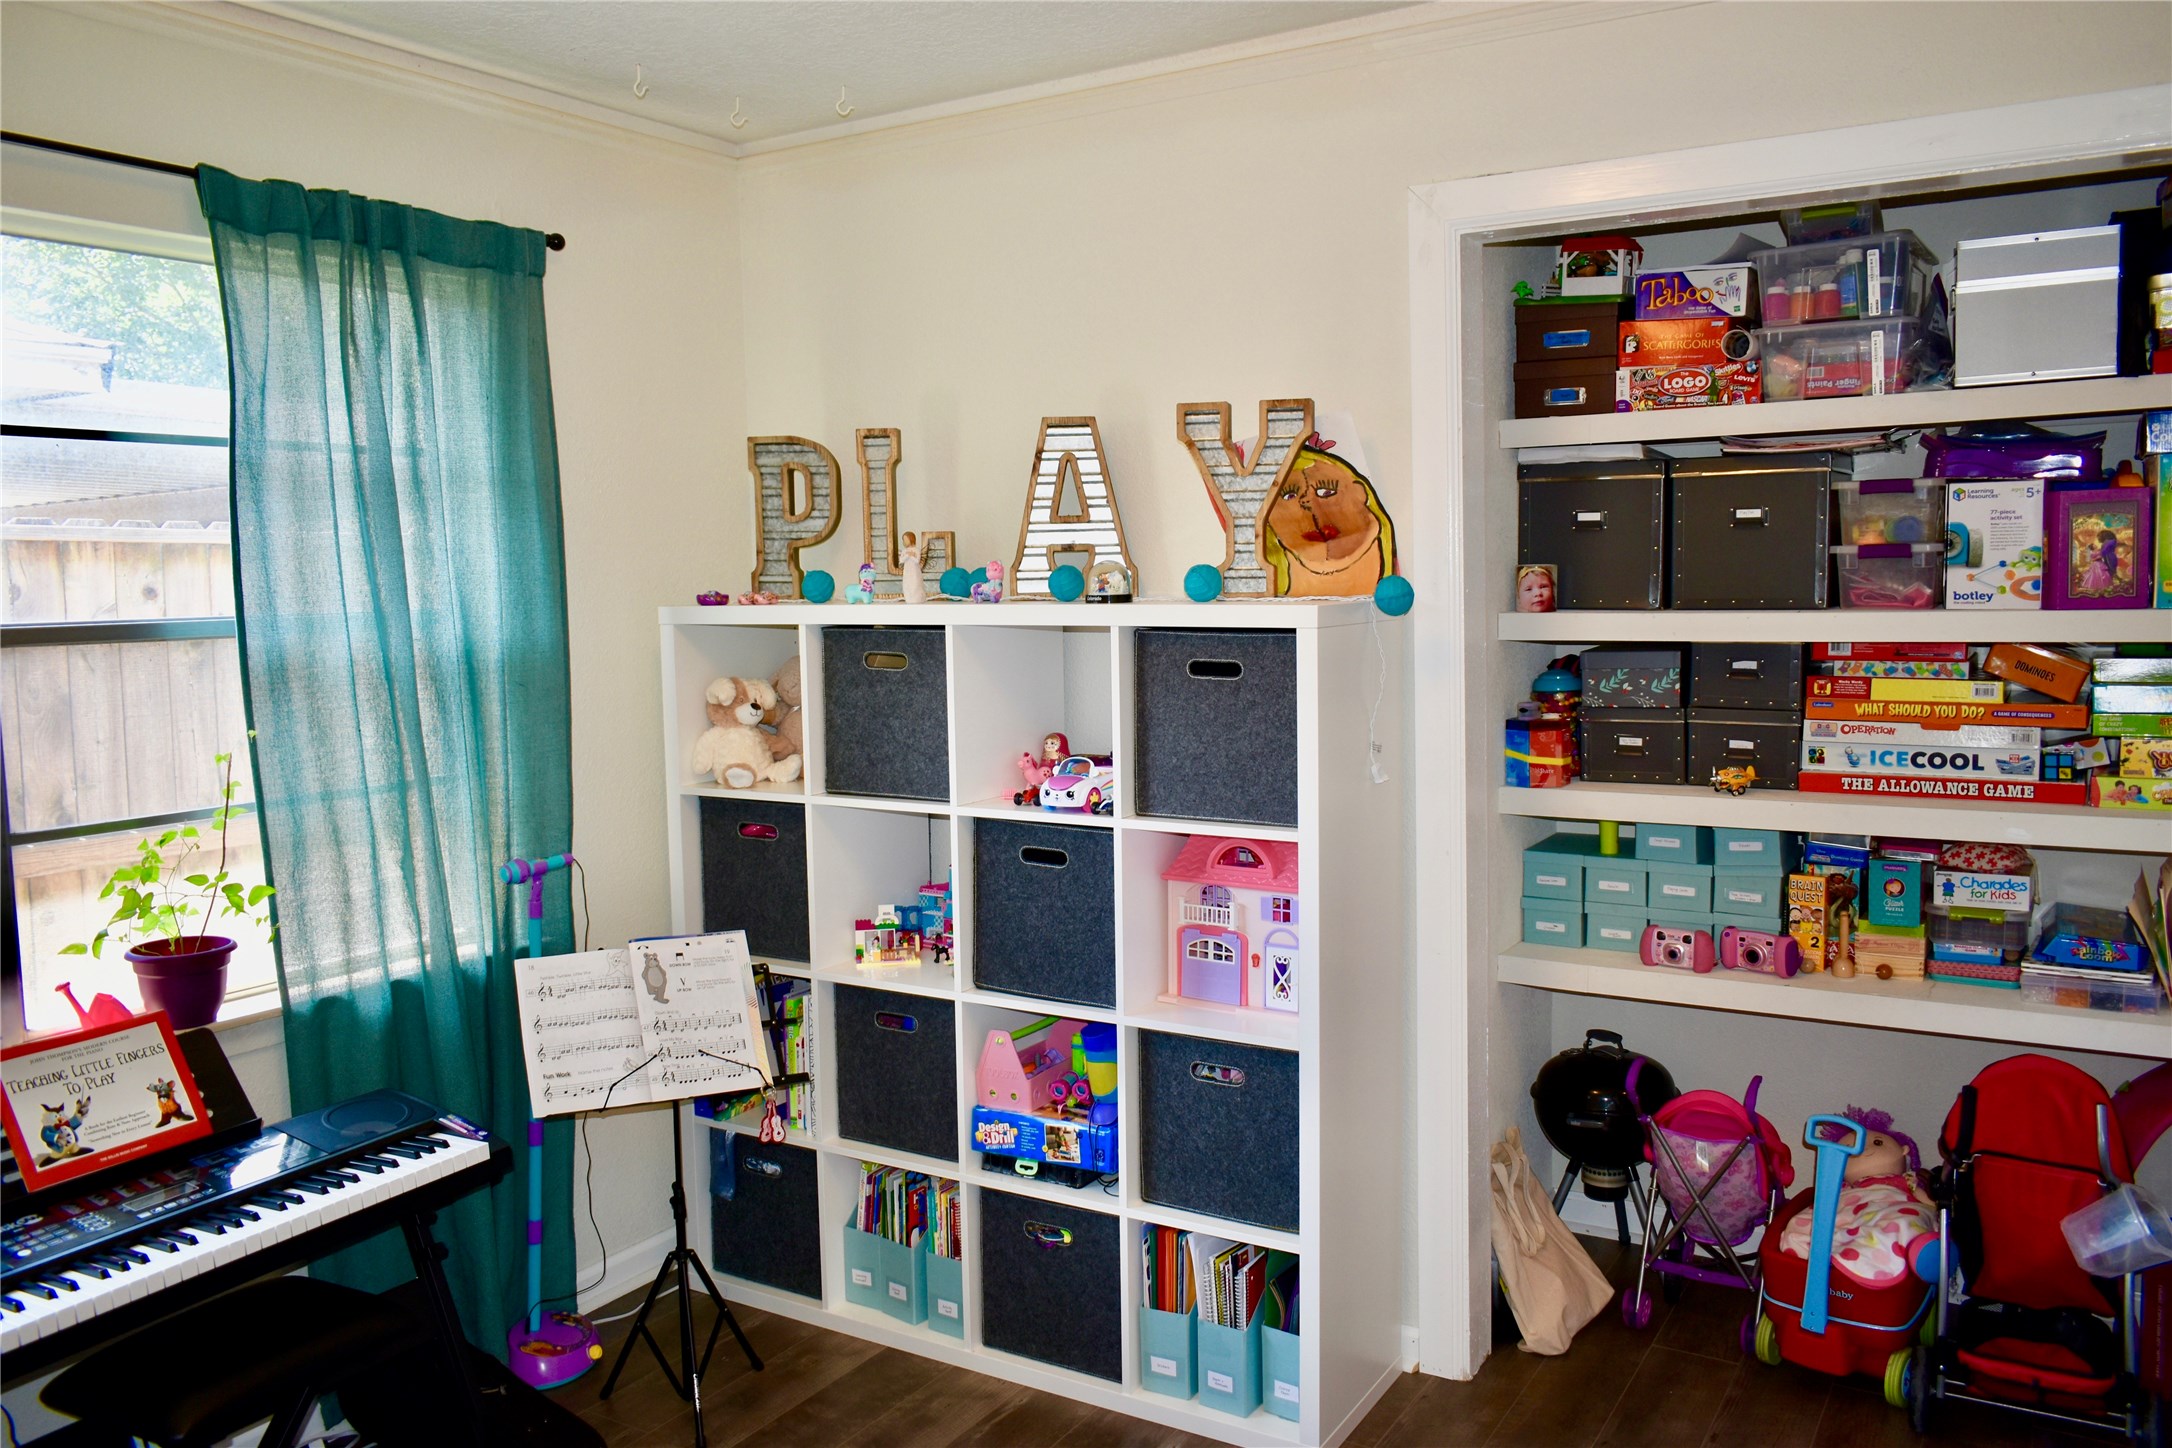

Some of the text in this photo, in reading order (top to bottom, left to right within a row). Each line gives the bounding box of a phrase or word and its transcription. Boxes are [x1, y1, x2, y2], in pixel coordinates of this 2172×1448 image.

[1641, 277, 1714, 310] Taboo
[1643, 338, 1721, 351] SCATTERGORIES
[1663, 376, 1707, 389] LOGO
[1807, 379, 1833, 388] Paints
[747, 398, 1315, 600] PLAY
[2026, 487, 2041, 498] 5+
[1953, 591, 1993, 602] botley
[2014, 660, 2056, 682] DOMINOES
[1854, 703, 1985, 720] WHAT SHOULD YOU DO?
[1840, 723, 1896, 736] OPERATION
[1841, 778, 2034, 799] THE ALLOWANCE GAME
[1789, 879, 1824, 891] BRAIN
[1960, 876, 2028, 892] Charades
[1789, 891, 1823, 903] QUEST
[1970, 888, 2017, 900] for Kids
[1810, 936, 1820, 948] 2
[2070, 945, 2123, 960] Rainbow
[29, 1034, 130, 1065] JOHN THOMPSON'S MODERN COURSE
[86, 1047, 104, 1057] PIANO
[6, 1043, 165, 1095] TEACHING LITTLE FINGERS
[63, 1072, 117, 1096] TO PLAY
[978, 1122, 1010, 1133] Design
[120, 1149, 130, 1157] MUSIC
[131, 1144, 148, 1153] COMPANY
[1829, 1287, 1854, 1301] baby
